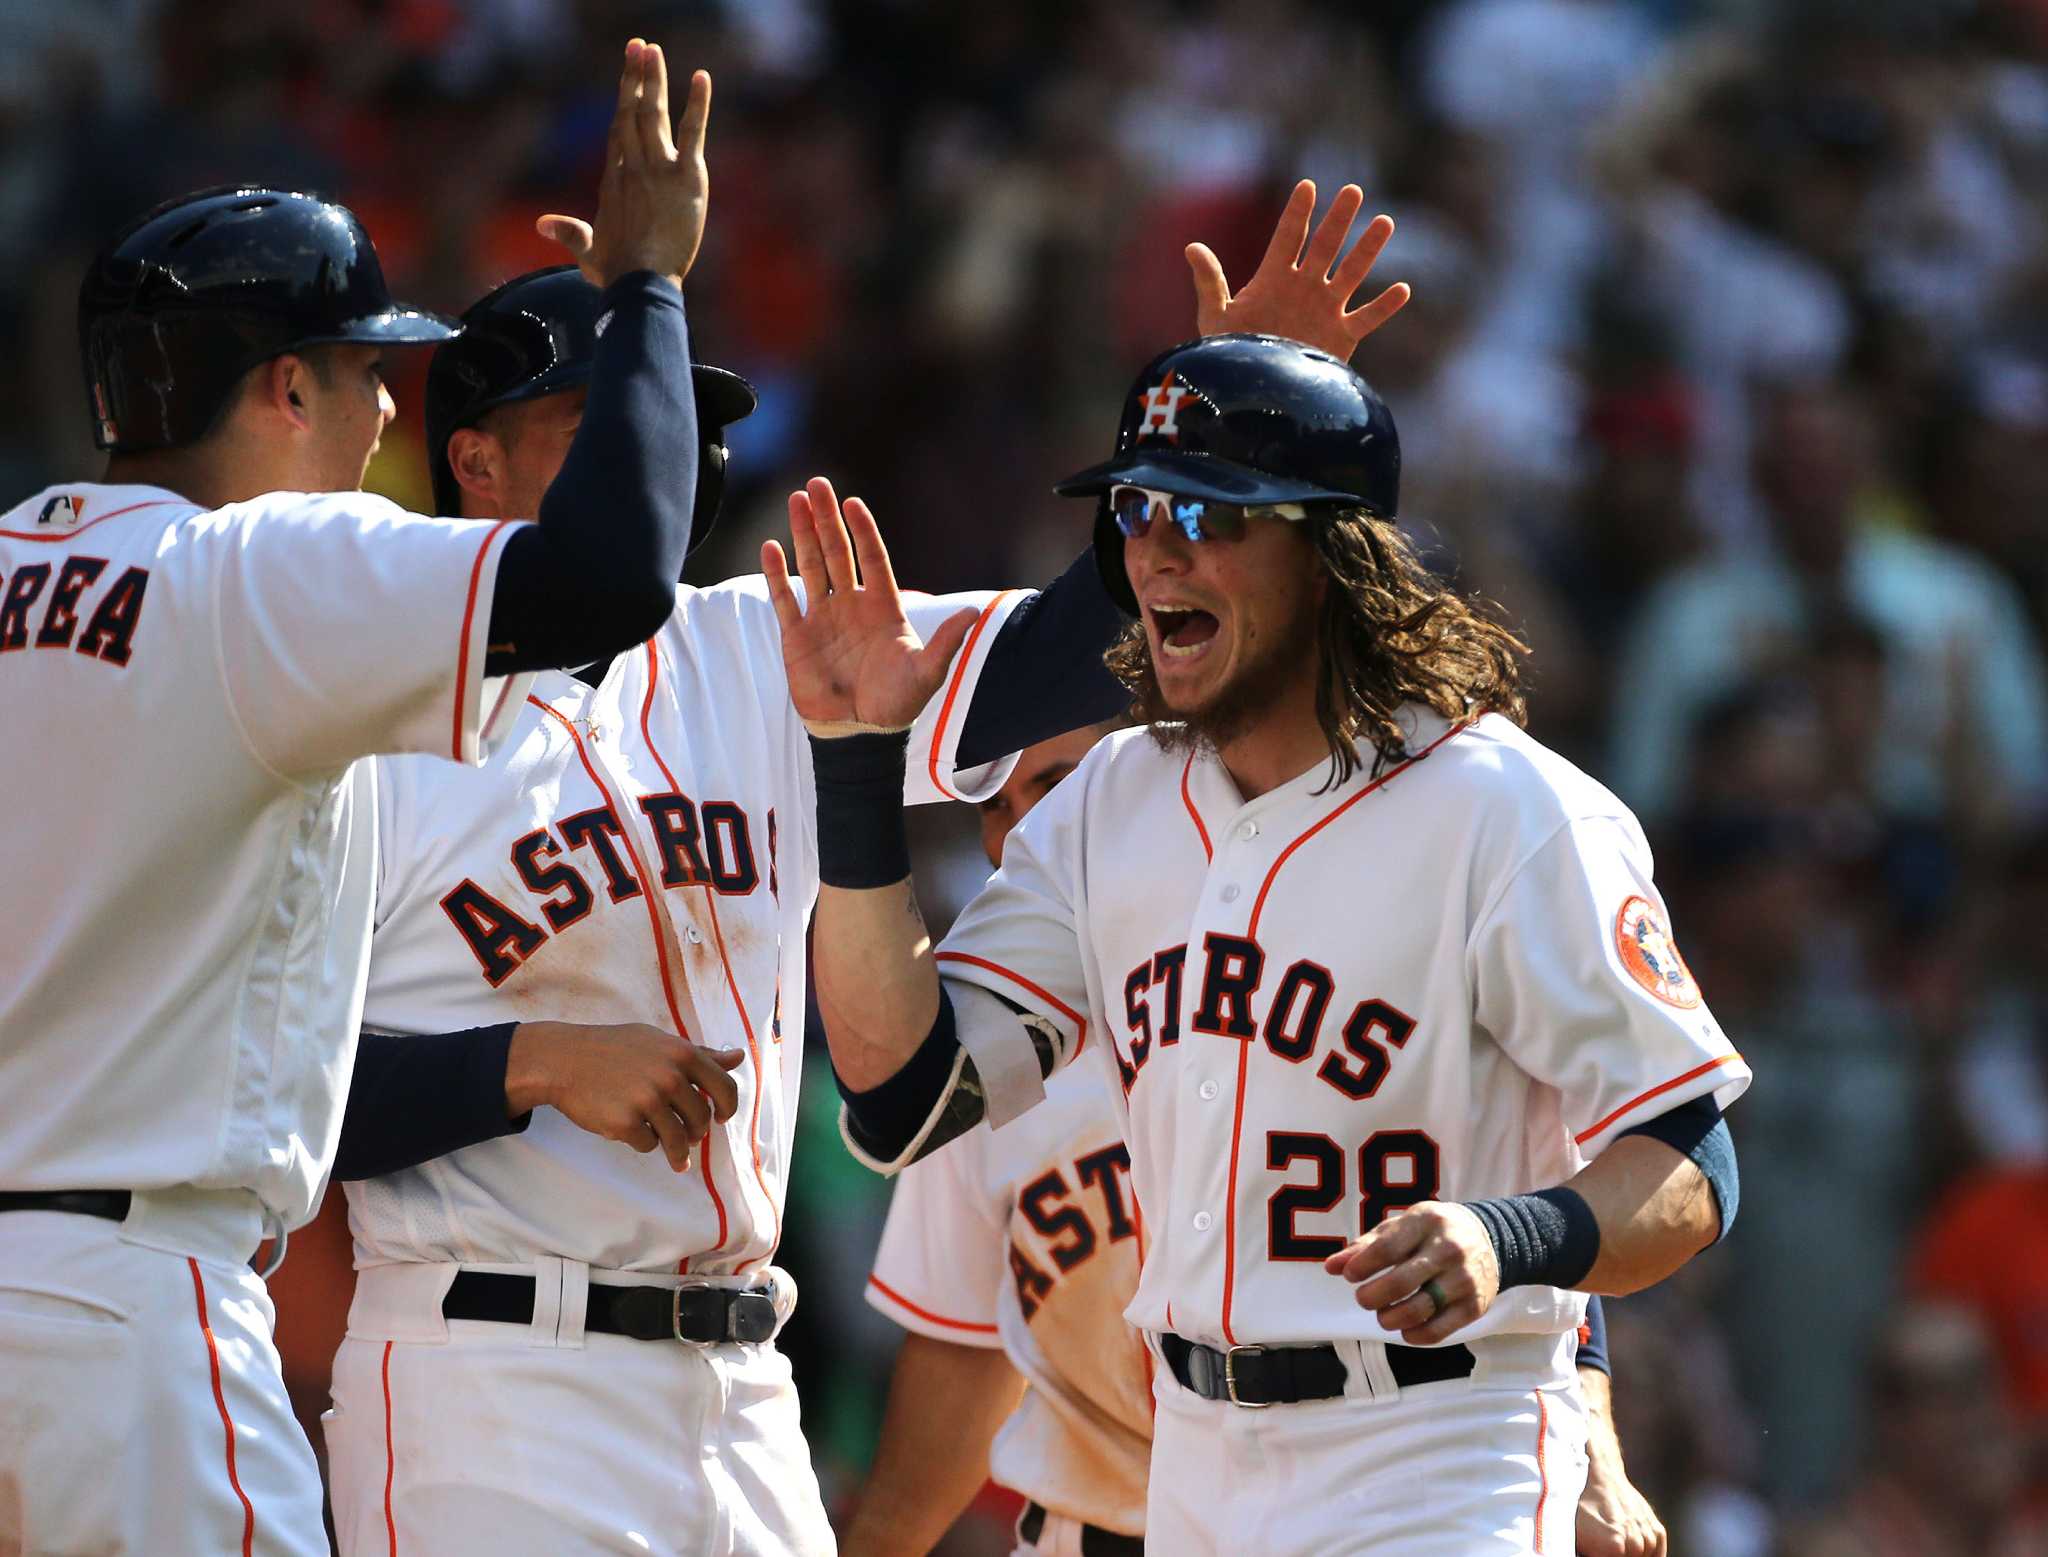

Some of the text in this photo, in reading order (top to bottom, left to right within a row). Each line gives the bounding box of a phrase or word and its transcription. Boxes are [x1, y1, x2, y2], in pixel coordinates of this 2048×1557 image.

[1139, 387, 1187, 434] H
[0, 556, 149, 669] REA
[439, 791, 778, 988] ASTRO
[1266, 1129, 1440, 1262] 28
